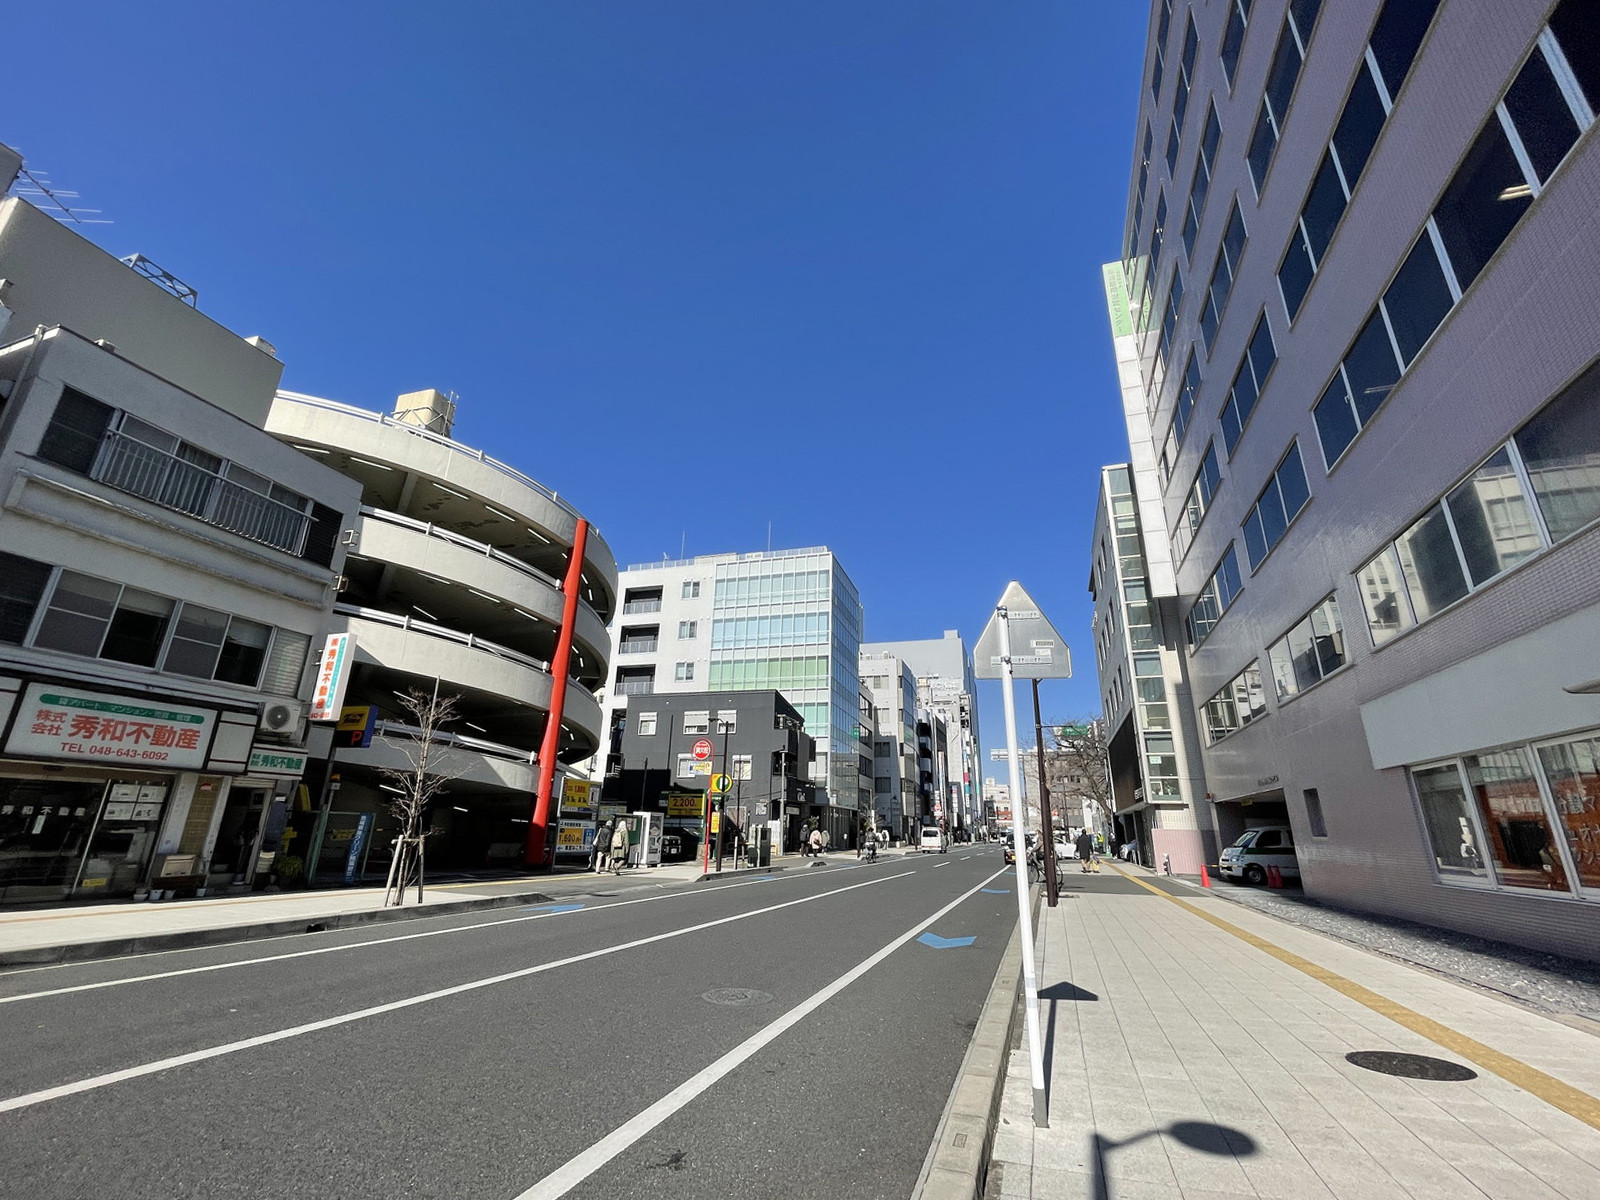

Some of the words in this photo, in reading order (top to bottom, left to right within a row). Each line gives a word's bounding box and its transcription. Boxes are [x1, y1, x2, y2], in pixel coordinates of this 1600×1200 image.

[36, 708, 68, 724] 株式
[31, 722, 64, 736] 会社
[67, 714, 201, 750] 秀和不動産
[351, 730, 363, 746] P
[60, 742, 85, 754] TEL
[89, 745, 169, 761] 048-643-6092
[260, 755, 303, 769] 秀和不動産
